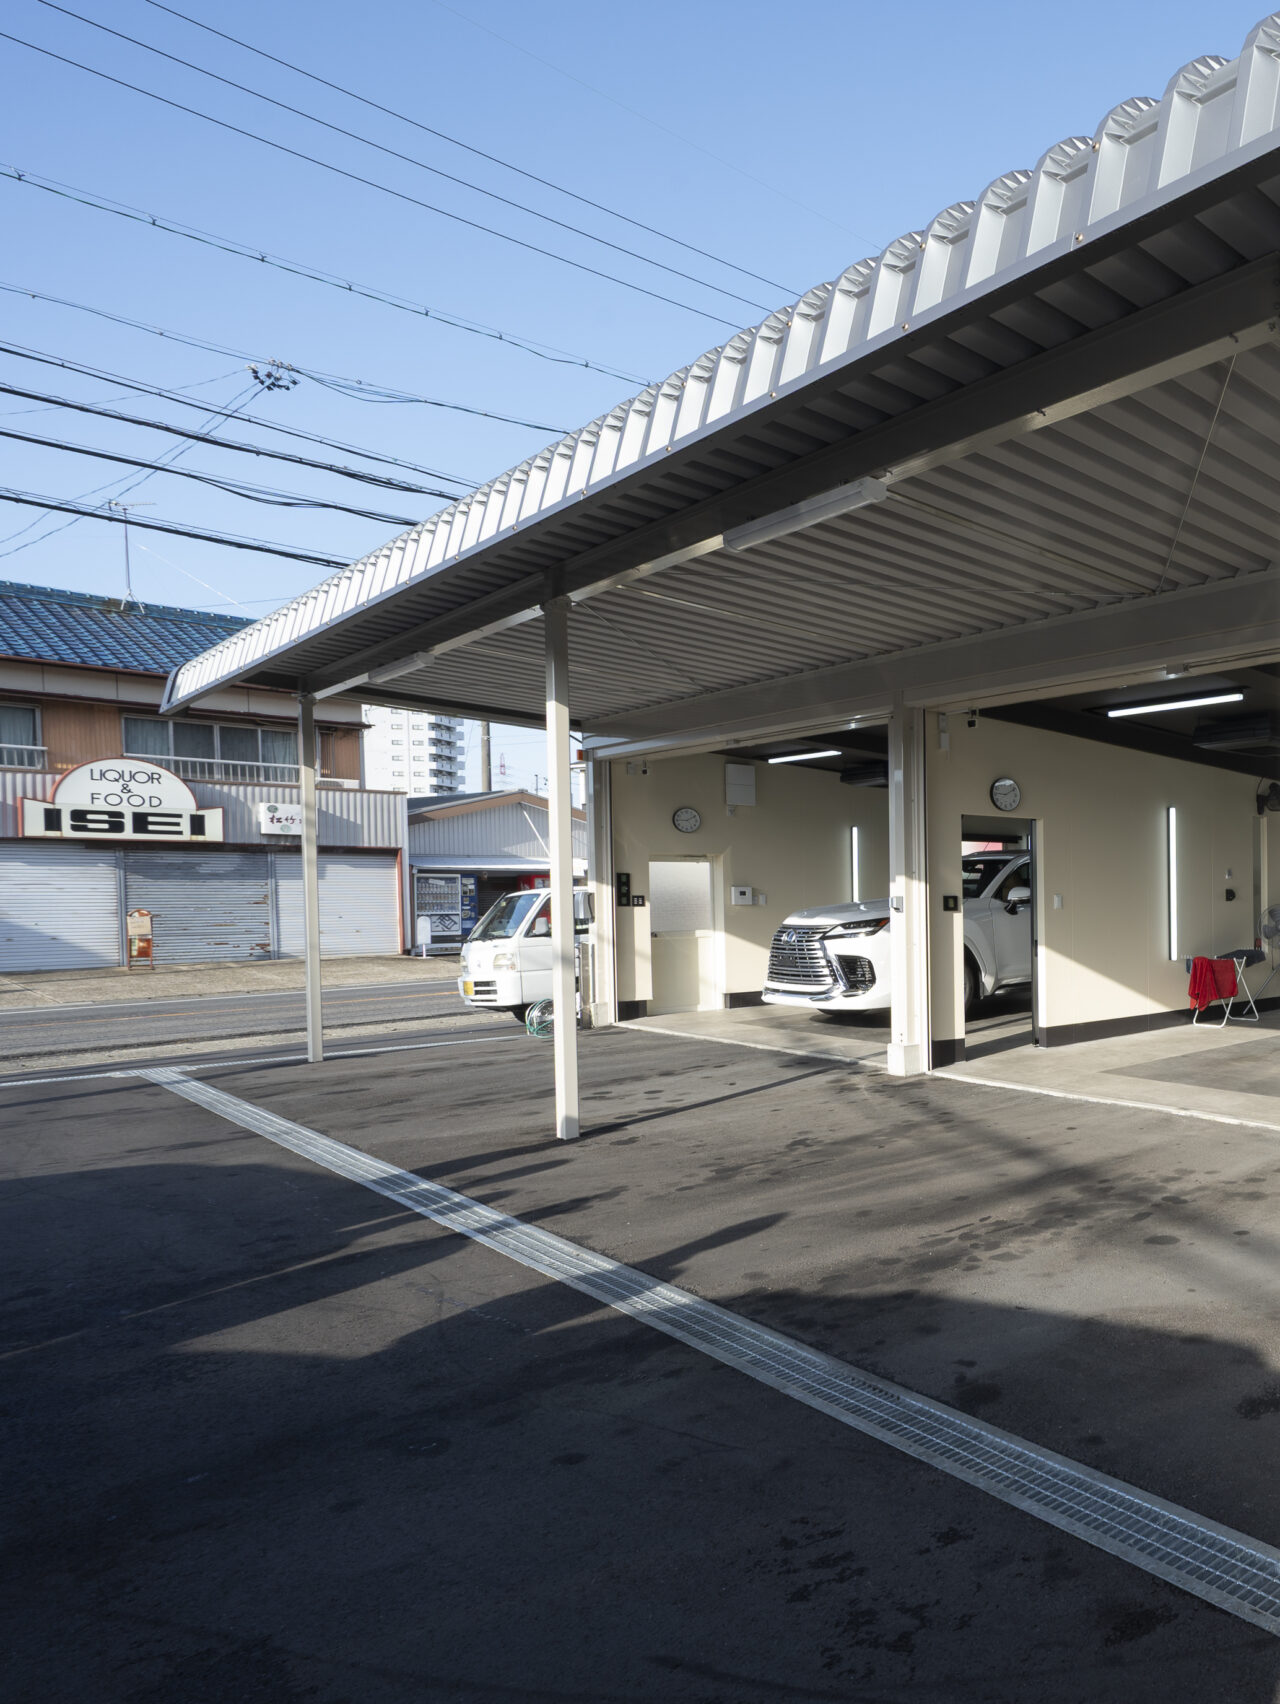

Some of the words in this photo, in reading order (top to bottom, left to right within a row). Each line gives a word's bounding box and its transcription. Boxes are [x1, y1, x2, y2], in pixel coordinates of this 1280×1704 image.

[90, 768, 162, 785] LIQUOR
[120, 783, 133, 794] &
[91, 793, 162, 808] FOOD
[44, 808, 206, 836] ISEI
[269, 813, 302, 825] 松竹
